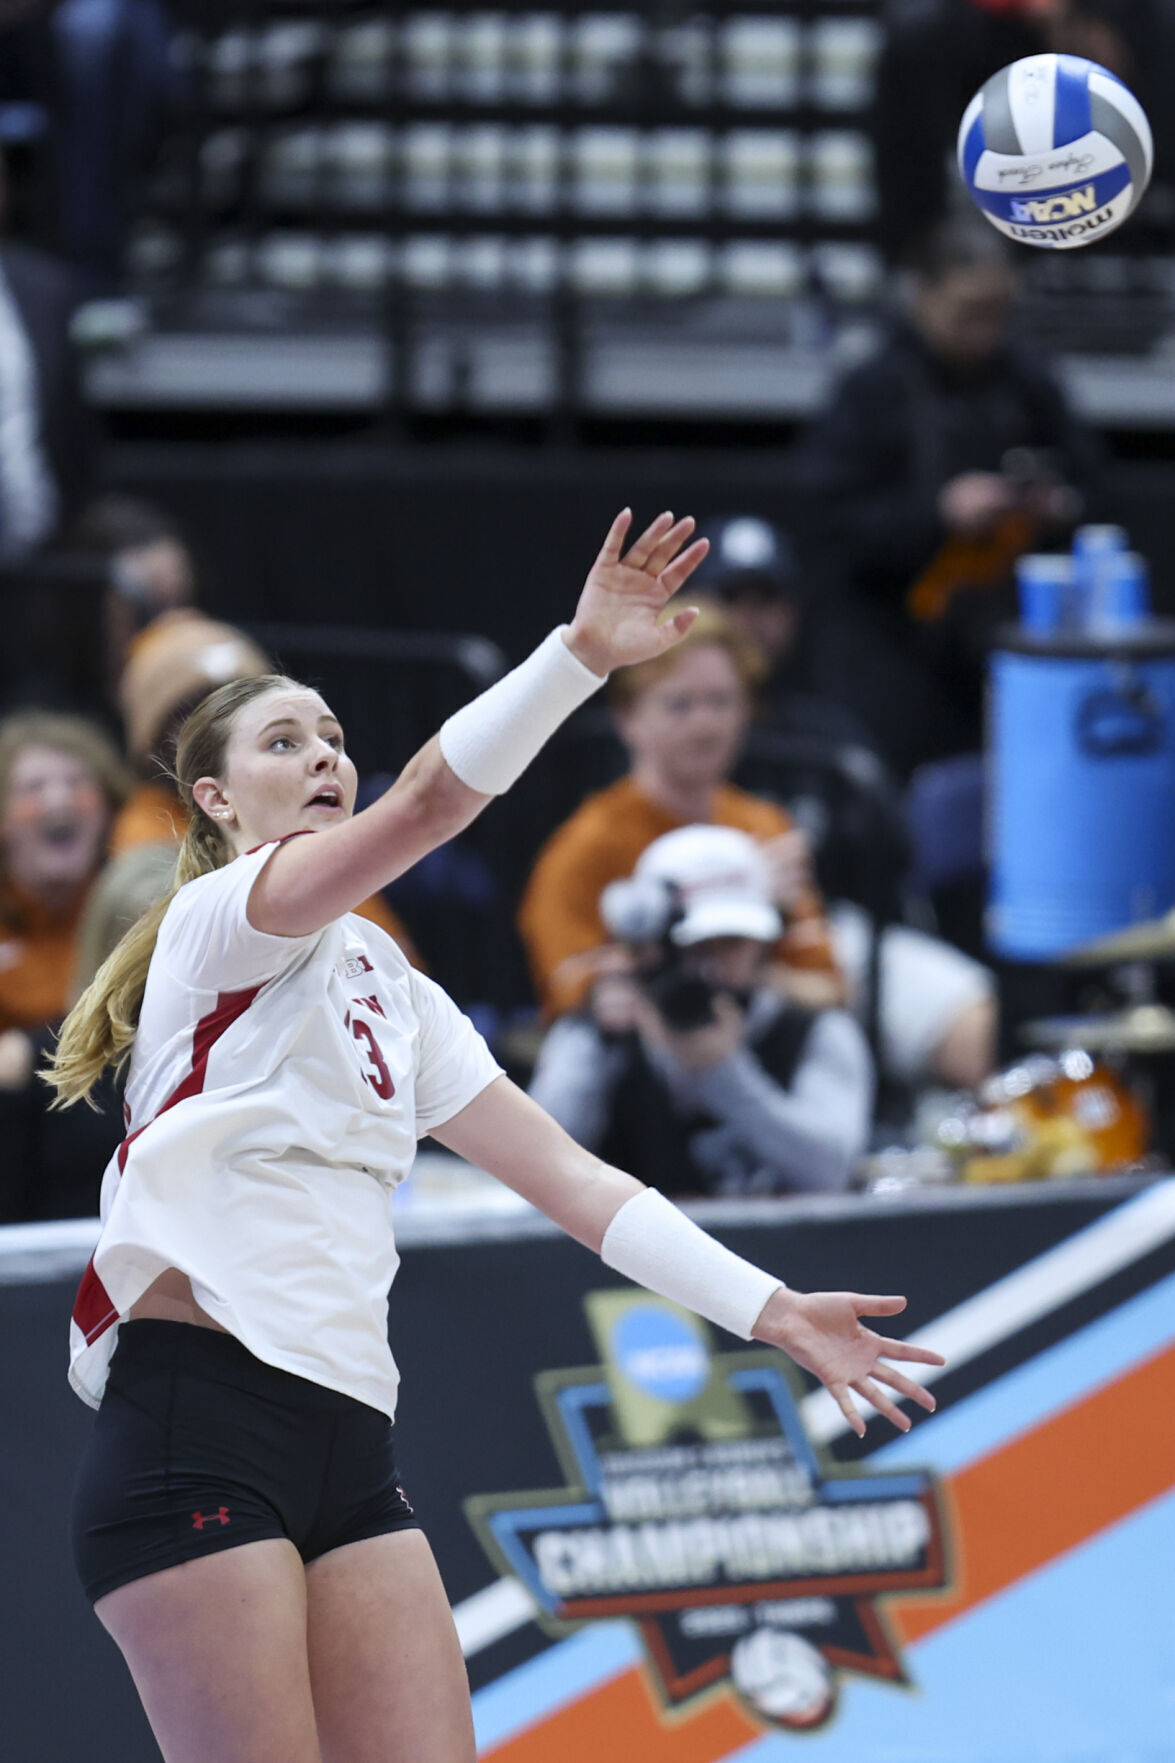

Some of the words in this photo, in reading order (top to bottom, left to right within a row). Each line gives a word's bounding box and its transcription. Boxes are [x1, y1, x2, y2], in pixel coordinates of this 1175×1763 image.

[1009, 184, 1097, 222] NCAA
[1010, 207, 1114, 241] molten
[534, 1502, 929, 1595] CHAMPIONSHIP
